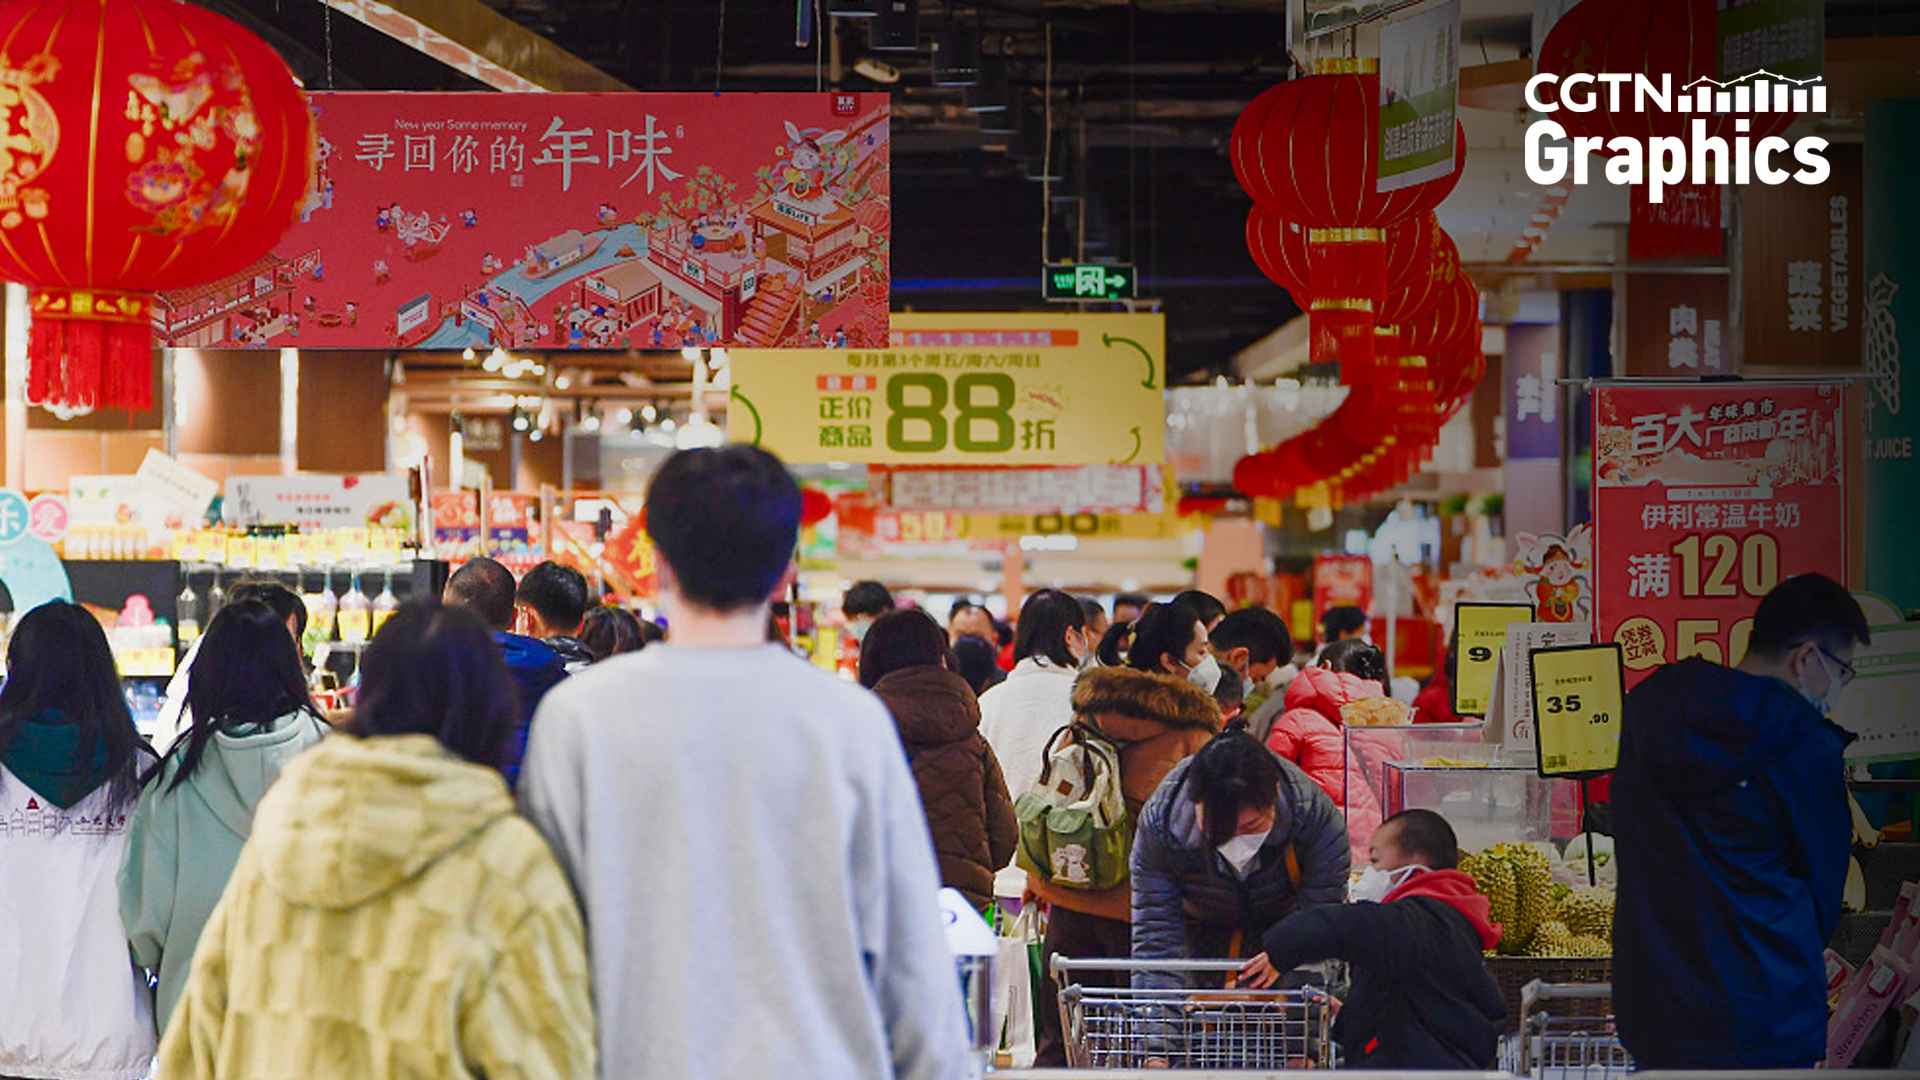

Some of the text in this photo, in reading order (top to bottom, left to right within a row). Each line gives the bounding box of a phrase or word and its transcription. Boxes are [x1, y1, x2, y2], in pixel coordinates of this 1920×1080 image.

[395, 118, 418, 130] New
[421, 121, 445, 133] year
[1829, 195, 1848, 332] VEGETABLES
[1788, 260, 1822, 331] 蔬菜
[819, 396, 872, 419] 正价
[887, 373, 1015, 452] 88
[1708, 398, 1776, 422] 年味集市
[819, 425, 873, 447] 商品
[1874, 436, 1913, 459] JUICE
[1641, 503, 1800, 530] 伊利常温牛奶
[1627, 534, 1778, 598] 满 120
[1468, 647, 1492, 662] 9
[1546, 695, 1609, 725] 35 .90
